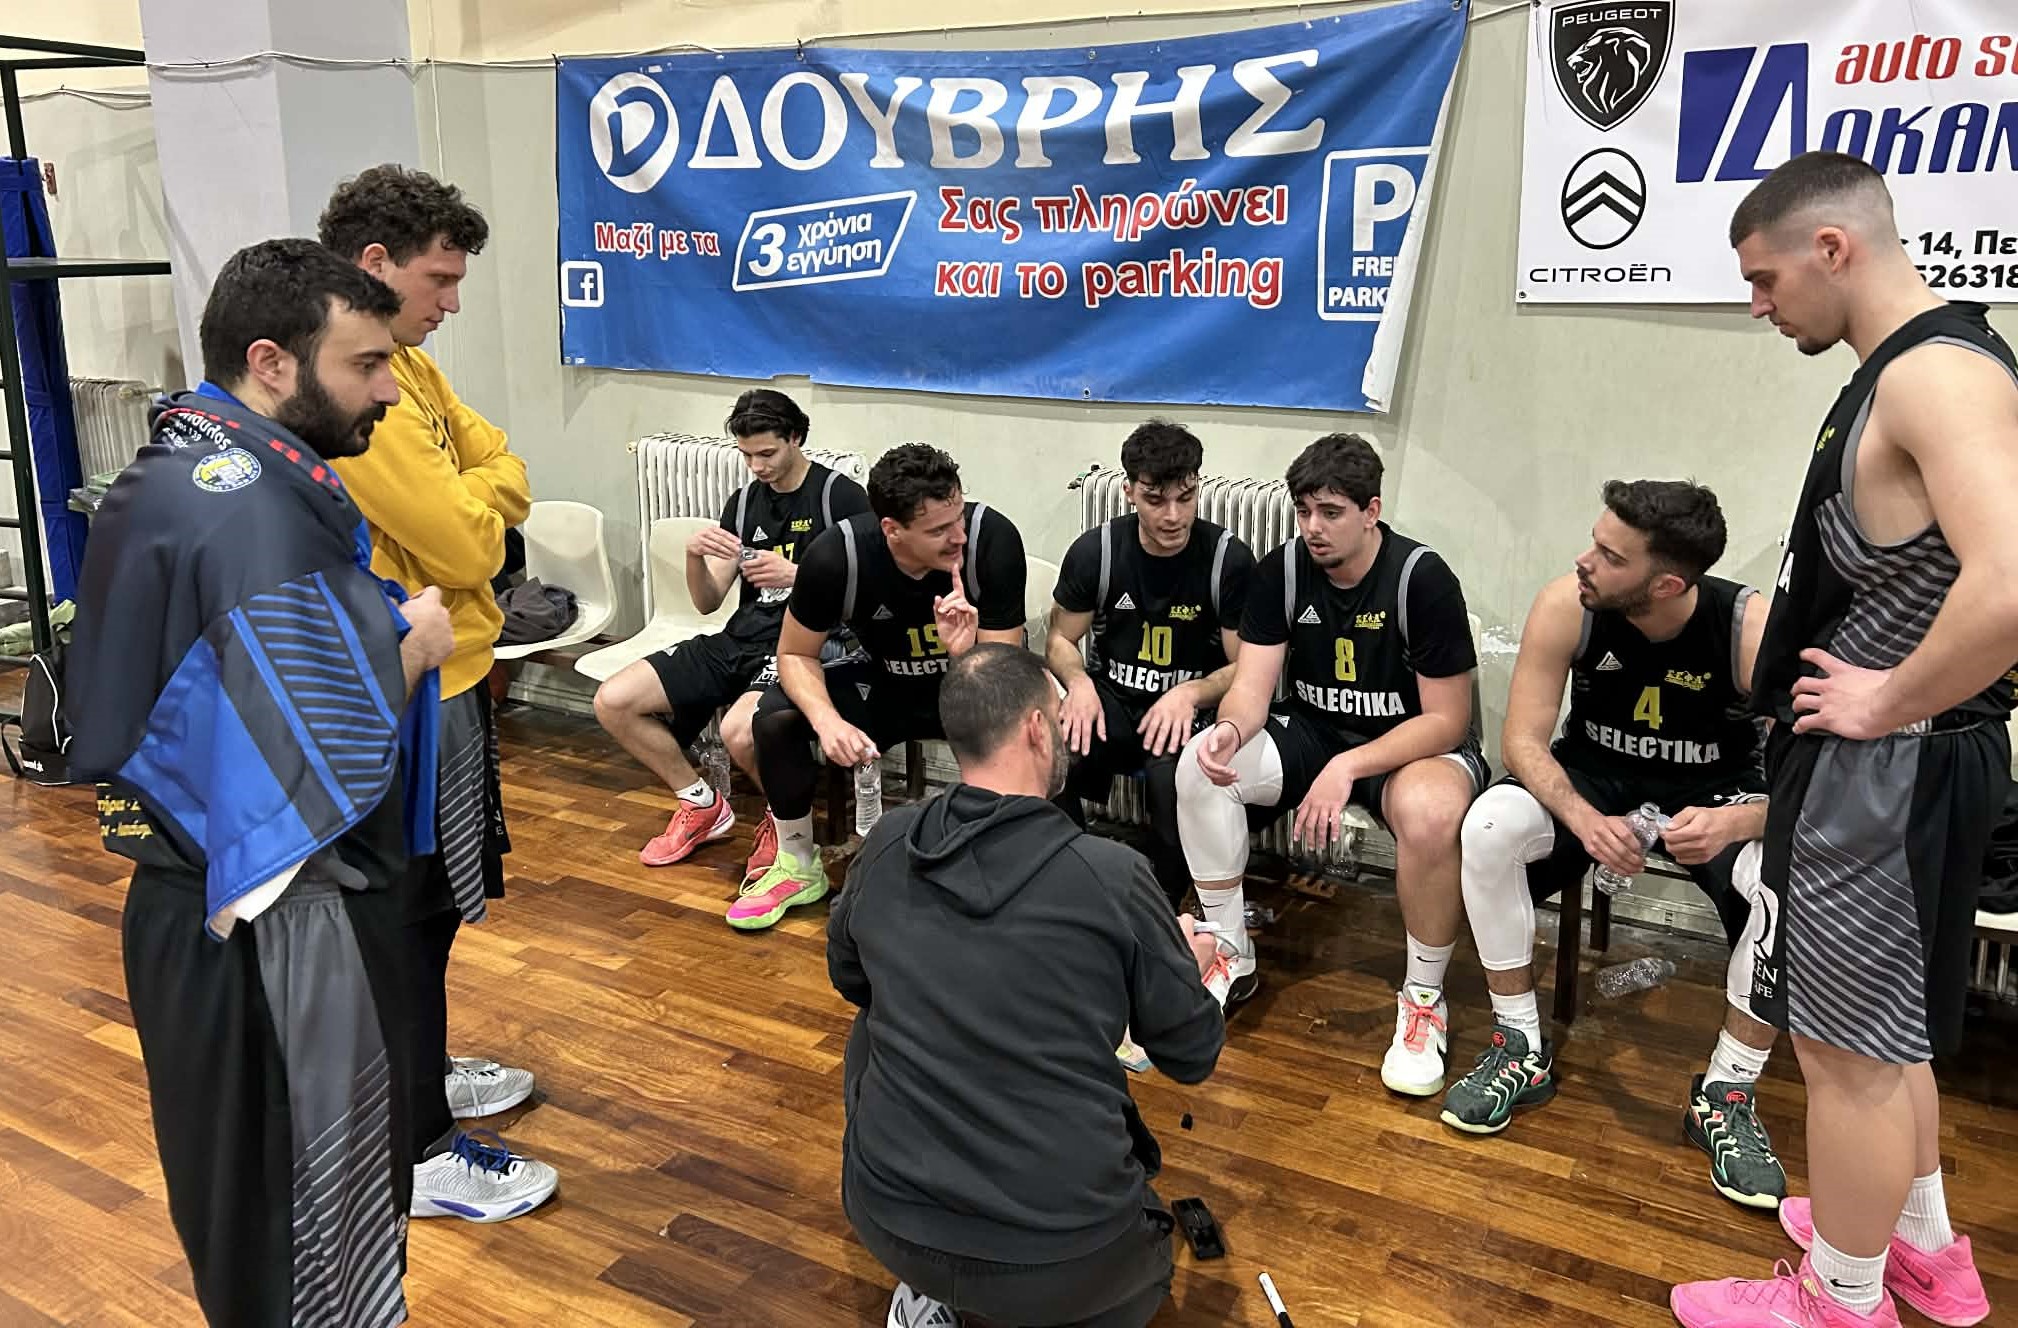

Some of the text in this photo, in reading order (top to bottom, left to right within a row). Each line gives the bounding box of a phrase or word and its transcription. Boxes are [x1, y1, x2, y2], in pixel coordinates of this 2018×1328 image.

[1562, 8, 1663, 28] PEUGEOT
[1834, 34, 2018, 84] auto s
[687, 48, 1326, 171] ΔΟΥΒΡΗΣ
[798, 211, 873, 249] χρόνια
[939, 178, 1289, 243] Σας πληρώνει
[1352, 163, 1417, 252] P
[595, 222, 721, 261] Μαζί με τα
[748, 223, 882, 277] 3 εγγύηση
[1918, 231, 1962, 260] 14,
[935, 247, 1283, 309] και το parking
[1530, 263, 1671, 282] CITROËN
[1328, 286, 1390, 307] PARK
[1137, 620, 1173, 667] 10
[1335, 637, 1357, 682] 8
[883, 657, 949, 676] ELECT
[1108, 657, 1203, 692] SELECTIK
[1295, 679, 1406, 717] SELECTIKA
[1633, 685, 1663, 730] 4
[1585, 719, 1721, 764] SELECTIKA
